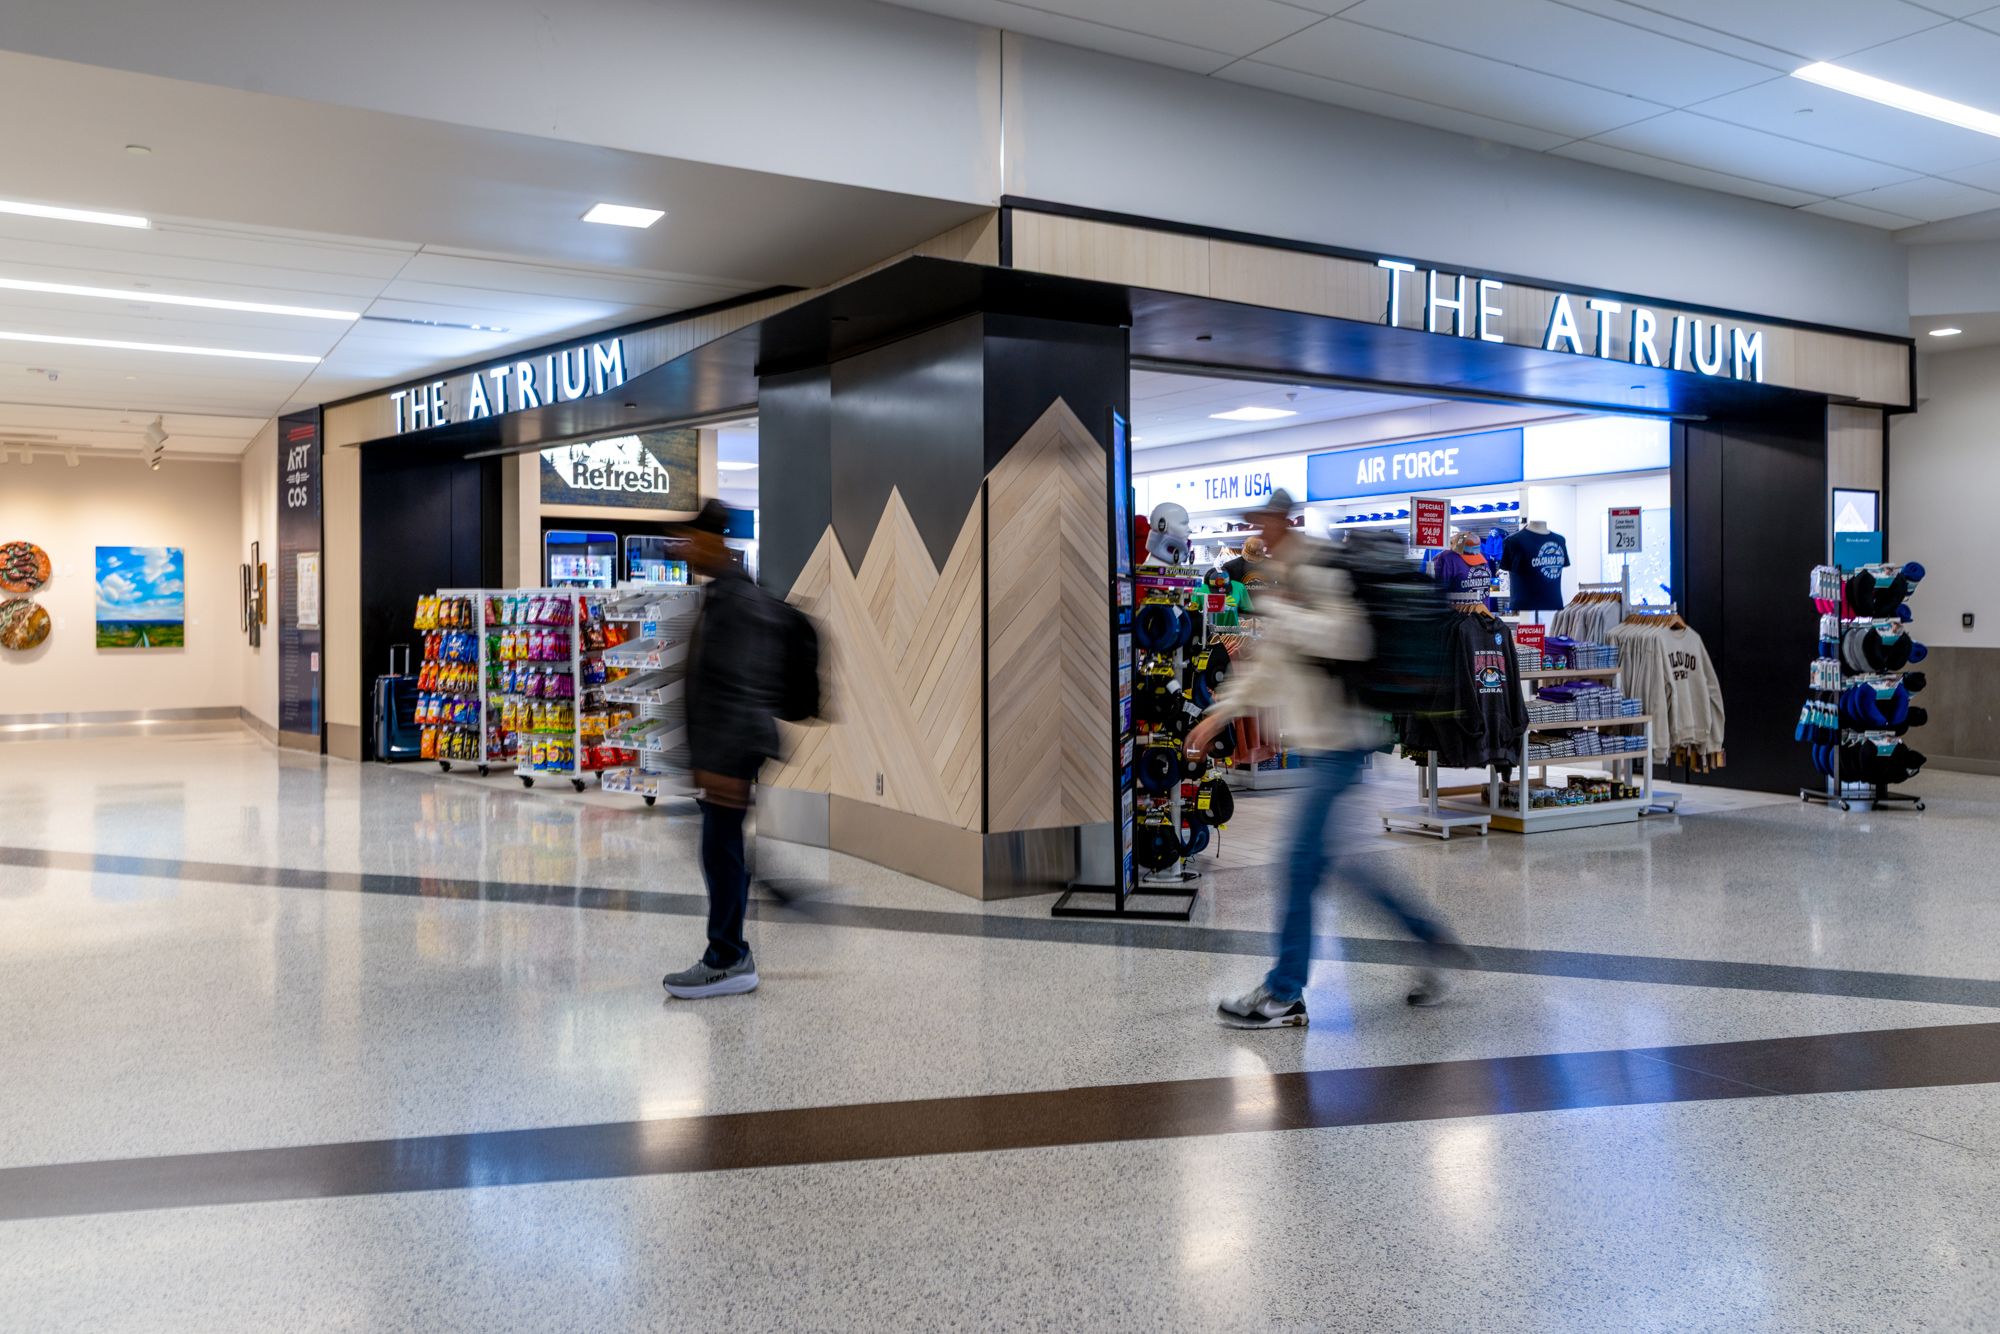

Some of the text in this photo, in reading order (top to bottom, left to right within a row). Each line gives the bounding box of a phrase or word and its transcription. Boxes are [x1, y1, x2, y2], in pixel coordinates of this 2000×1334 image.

[1378, 259, 1763, 383] THE ATRIUM
[391, 338, 624, 434] THE ATRIUM
[287, 443, 311, 471] ART
[1356, 448, 1460, 485] AIR FORCE
[572, 461, 668, 490] Refresh
[1204, 472, 1273, 500] TEAM USA
[288, 486, 308, 508] COS
[1418, 503, 1444, 511] SPECIAL!
[1615, 531, 1623, 548] 2
[1518, 627, 1544, 635] SPECIAL!
[705, 972, 727, 985] HOKA
